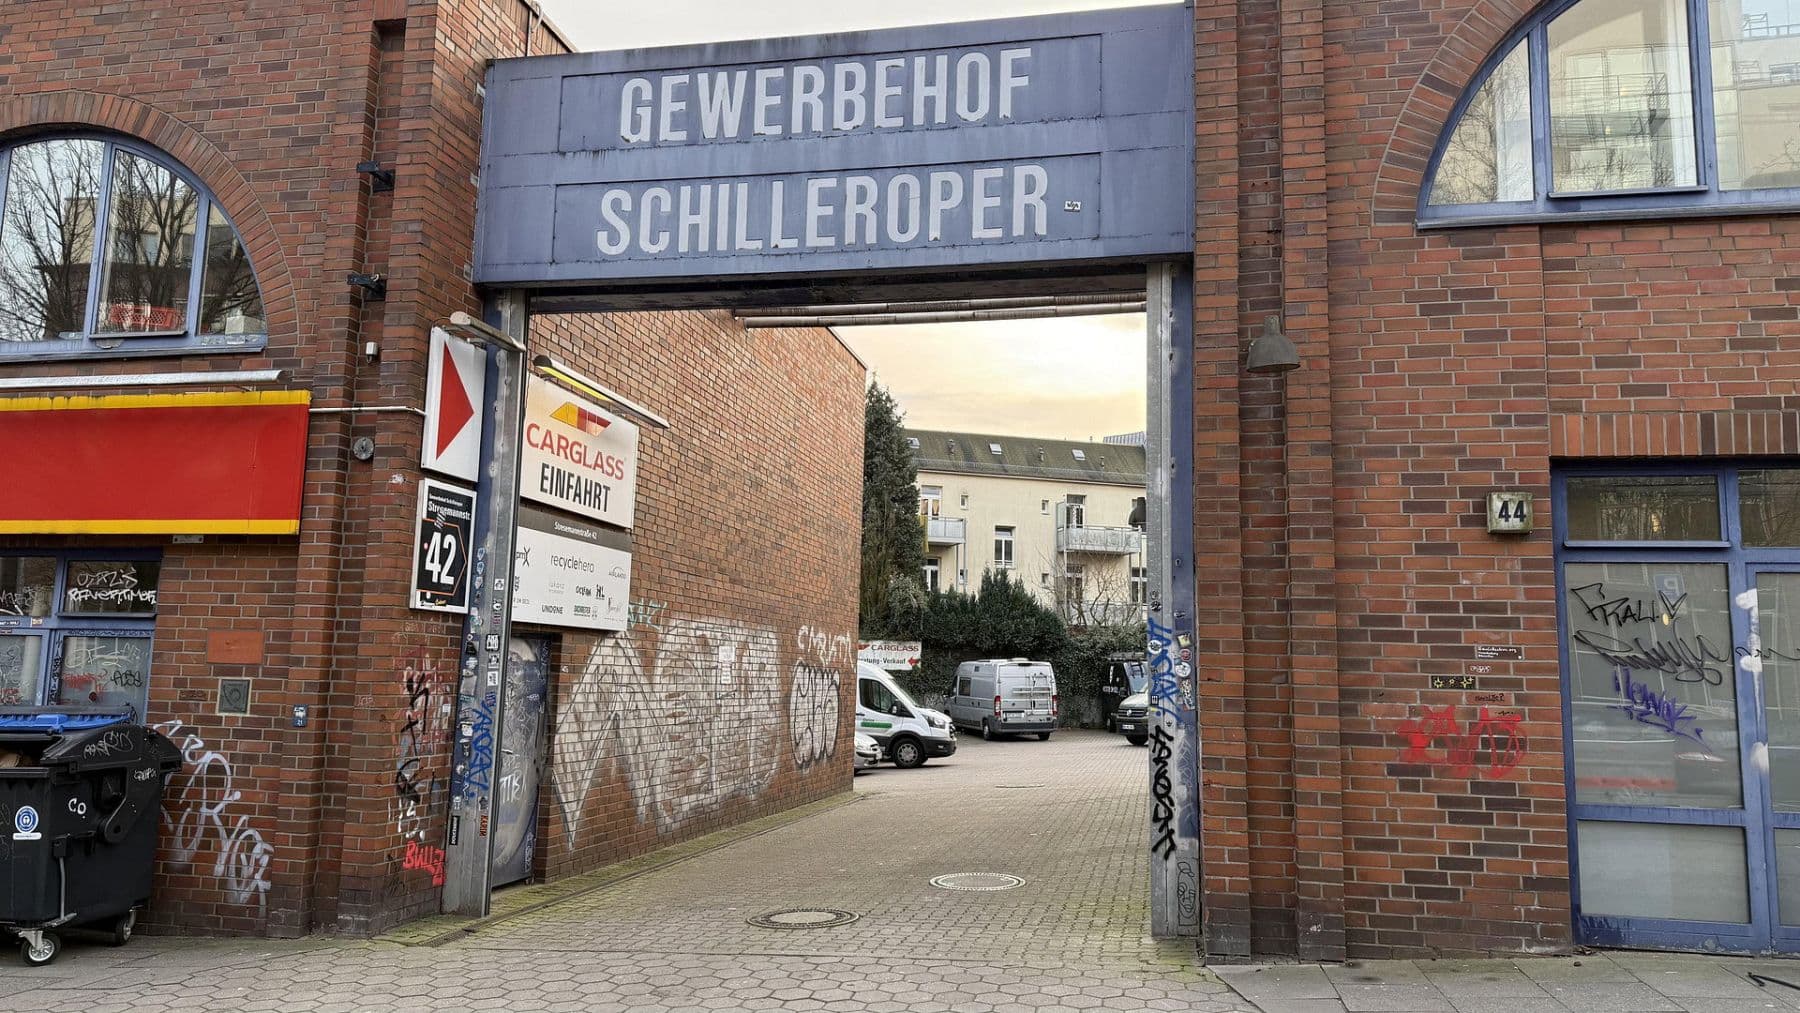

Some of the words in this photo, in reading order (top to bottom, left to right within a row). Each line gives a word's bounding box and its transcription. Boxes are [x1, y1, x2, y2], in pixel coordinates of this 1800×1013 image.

[619, 48, 1032, 143] GEWERBEHOF
[596, 165, 1050, 256] SCHILLEROPER
[526, 422, 624, 480] CARGLASS
[540, 462, 611, 513] EINFAHRT
[1498, 500, 1527, 522] 44
[425, 531, 455, 585] 42
[551, 554, 595, 573] recyclehero
[871, 644, 920, 652] CARGLASS
